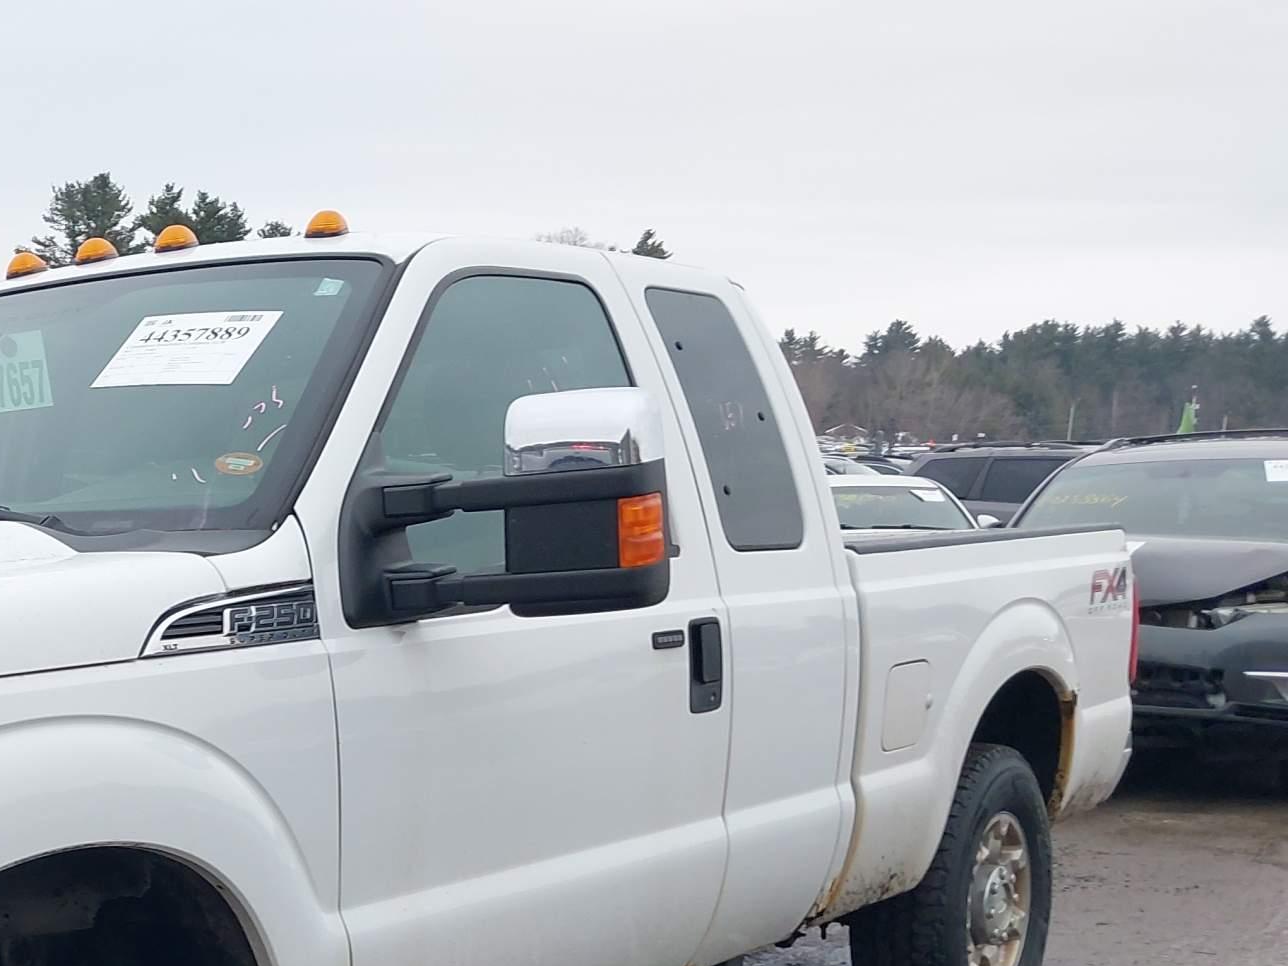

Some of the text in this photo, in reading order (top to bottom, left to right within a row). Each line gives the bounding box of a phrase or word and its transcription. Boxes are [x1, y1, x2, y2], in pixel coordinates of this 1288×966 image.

[139, 326, 251, 344] 44357889
[1089, 566, 1127, 606] FX4
[163, 643, 179, 651] XLT
